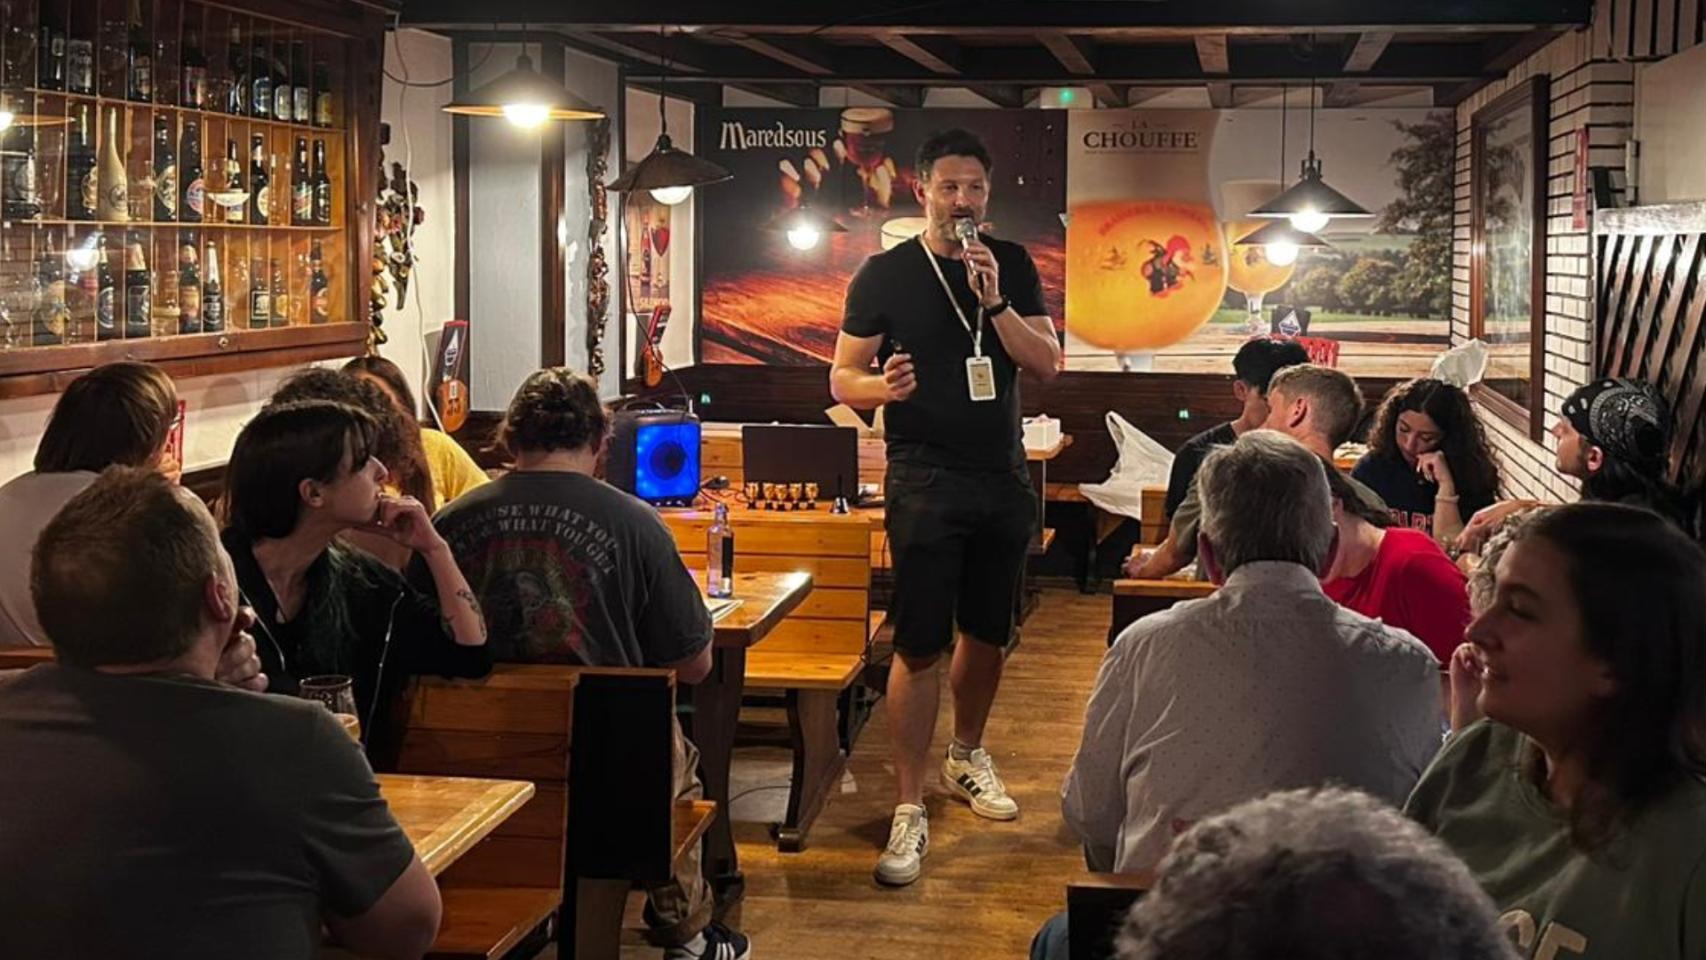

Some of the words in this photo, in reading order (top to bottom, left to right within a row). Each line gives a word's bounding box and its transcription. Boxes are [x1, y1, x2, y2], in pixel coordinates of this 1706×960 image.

[720, 121, 827, 149] Maredsous
[1083, 131, 1198, 148] CHOUFFE
[497, 518, 551, 532] WHAT
[554, 521, 587, 546] YOU
[585, 540, 616, 574] GET
[528, 504, 584, 525] WHAT
[585, 520, 619, 551] YOU
